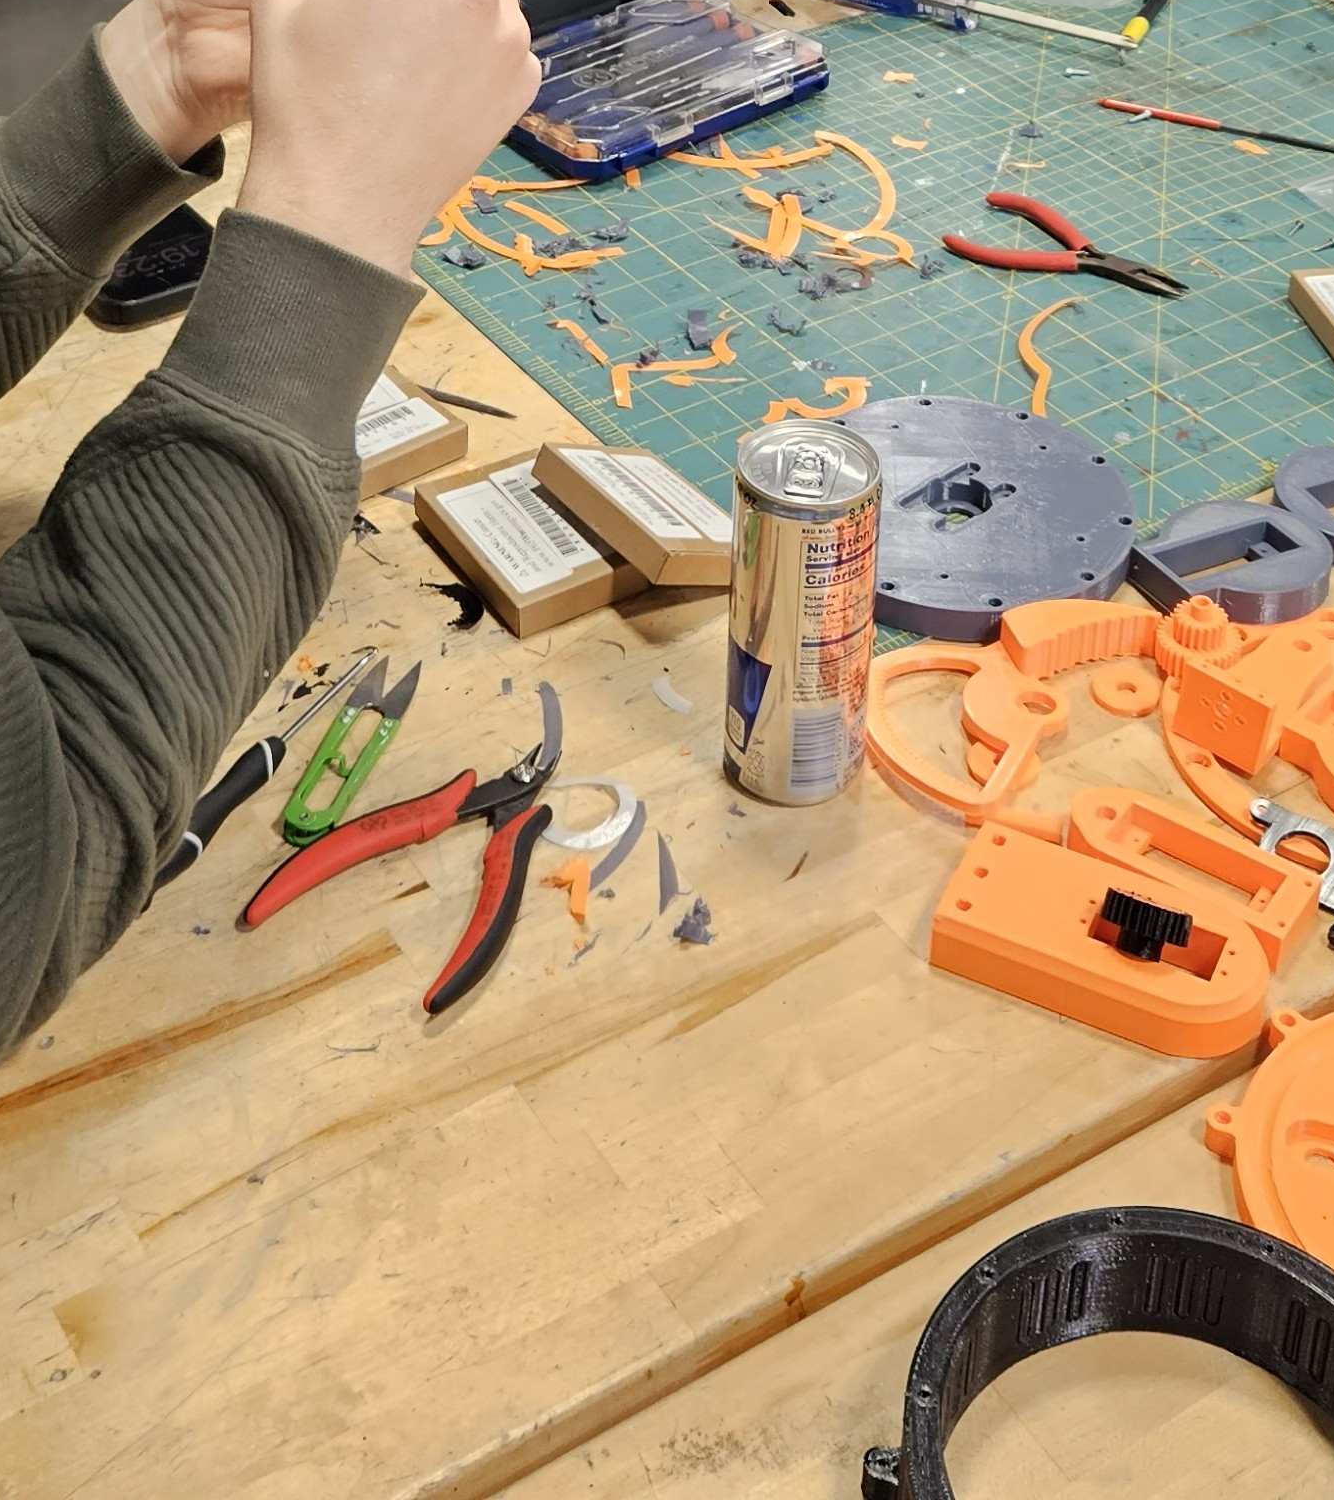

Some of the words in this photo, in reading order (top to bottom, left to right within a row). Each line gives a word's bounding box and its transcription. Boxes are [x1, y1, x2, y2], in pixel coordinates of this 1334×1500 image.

[801, 528, 816, 536] RED
[818, 527, 836, 536] BULL
[806, 529, 871, 554] Nutrition
[804, 564, 867, 586] Calories
